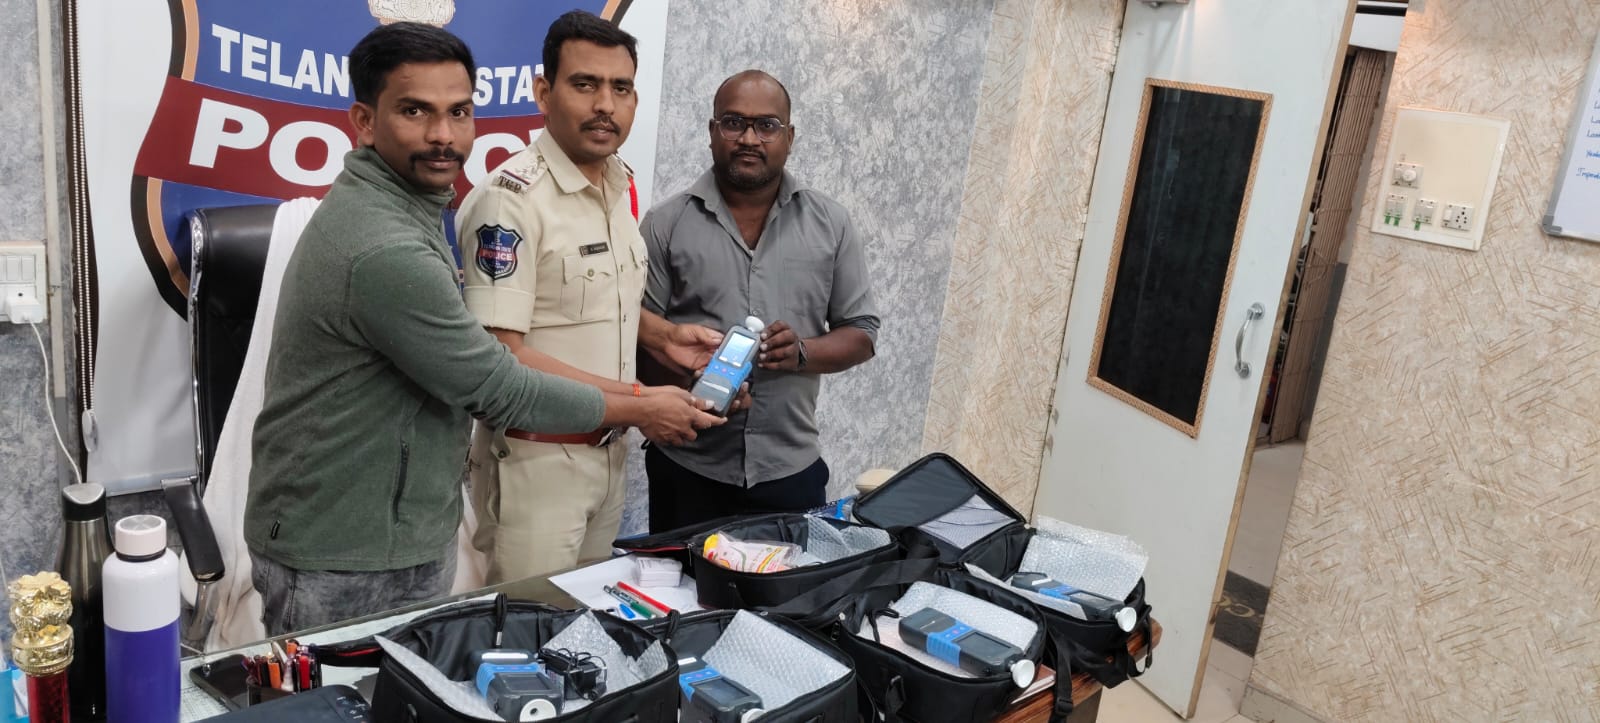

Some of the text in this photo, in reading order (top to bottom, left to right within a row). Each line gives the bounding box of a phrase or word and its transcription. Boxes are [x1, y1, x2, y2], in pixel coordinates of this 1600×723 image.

[212, 23, 545, 107] TELAN STA
[189, 98, 544, 188] POC
[482, 248, 513, 262] POLICE
